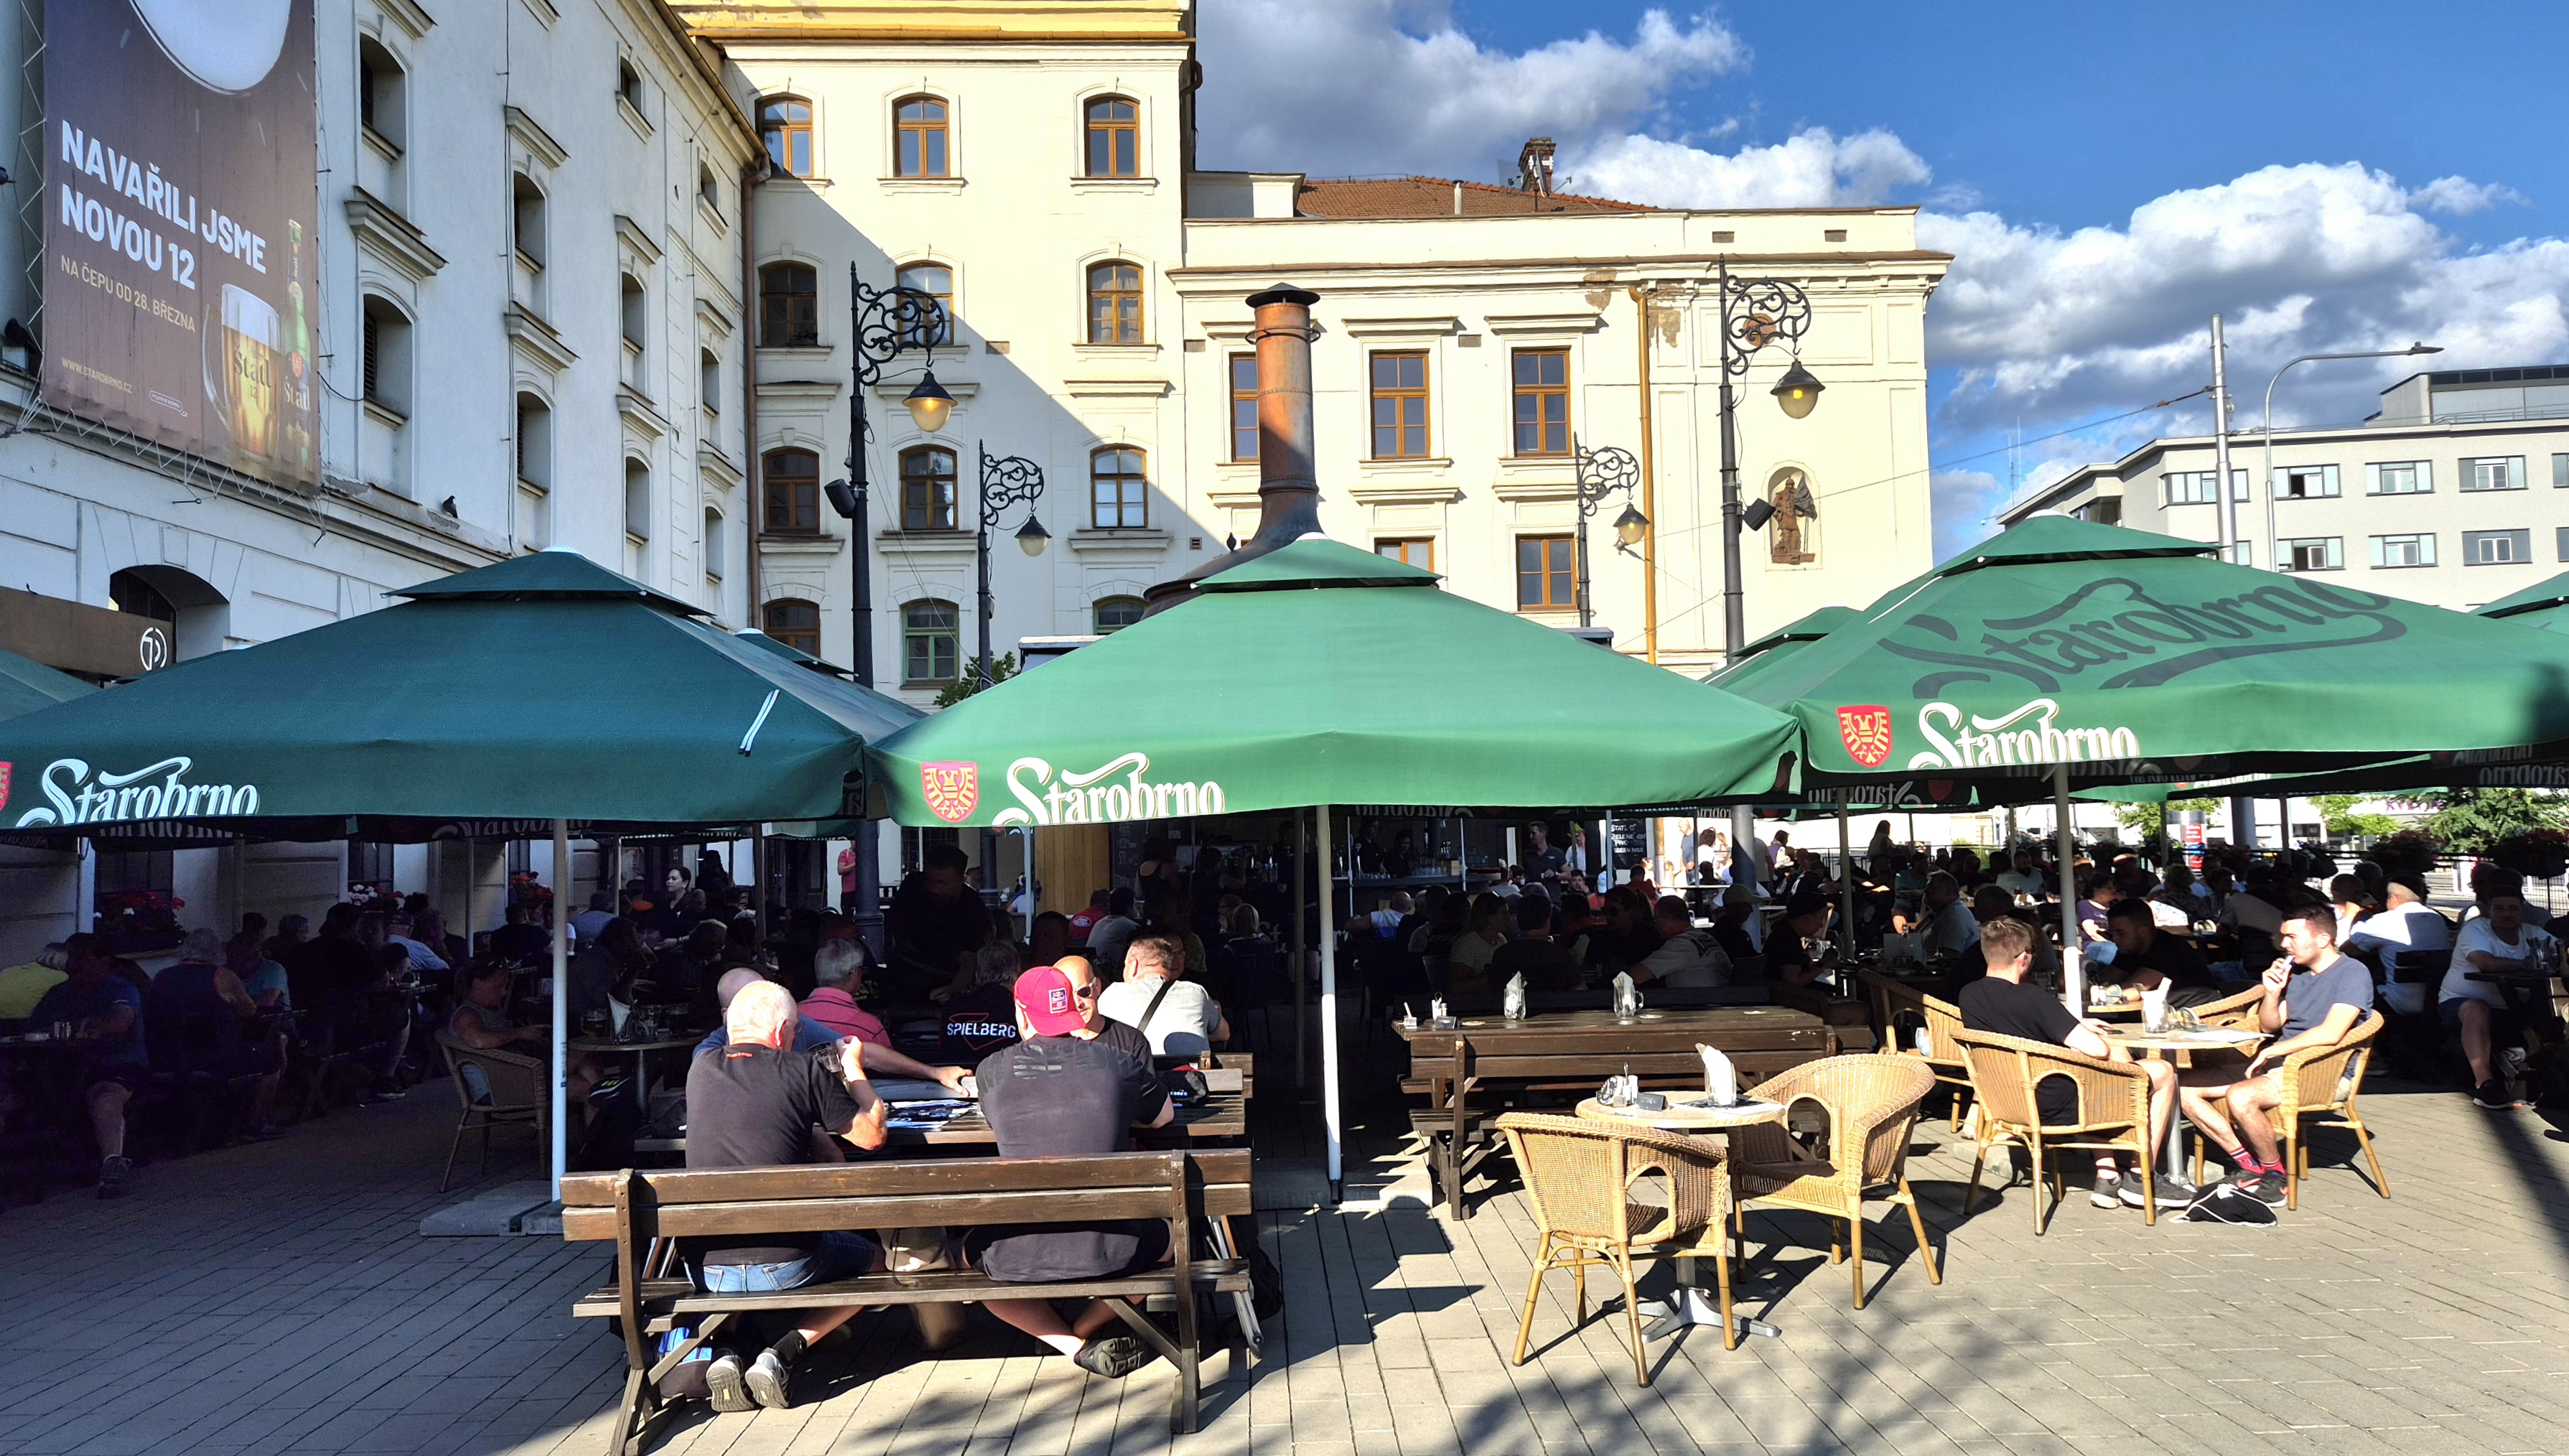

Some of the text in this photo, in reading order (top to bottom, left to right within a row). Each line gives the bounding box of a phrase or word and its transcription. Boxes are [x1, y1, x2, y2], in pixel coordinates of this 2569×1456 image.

[62, 119, 266, 274] NAVAŘILI JSME
[62, 183, 195, 290] NOVOU 12
[61, 255, 195, 332] NA ČEPU OD 28. BŘEZNA
[61, 357, 133, 394] WWW.STAROBRNO.CZ
[1908, 698, 2140, 771] Starobrno
[15, 756, 260, 828] Starobrno
[992, 752, 1226, 826] Starobrno
[947, 1023, 1017, 1038] SPIELBERG
